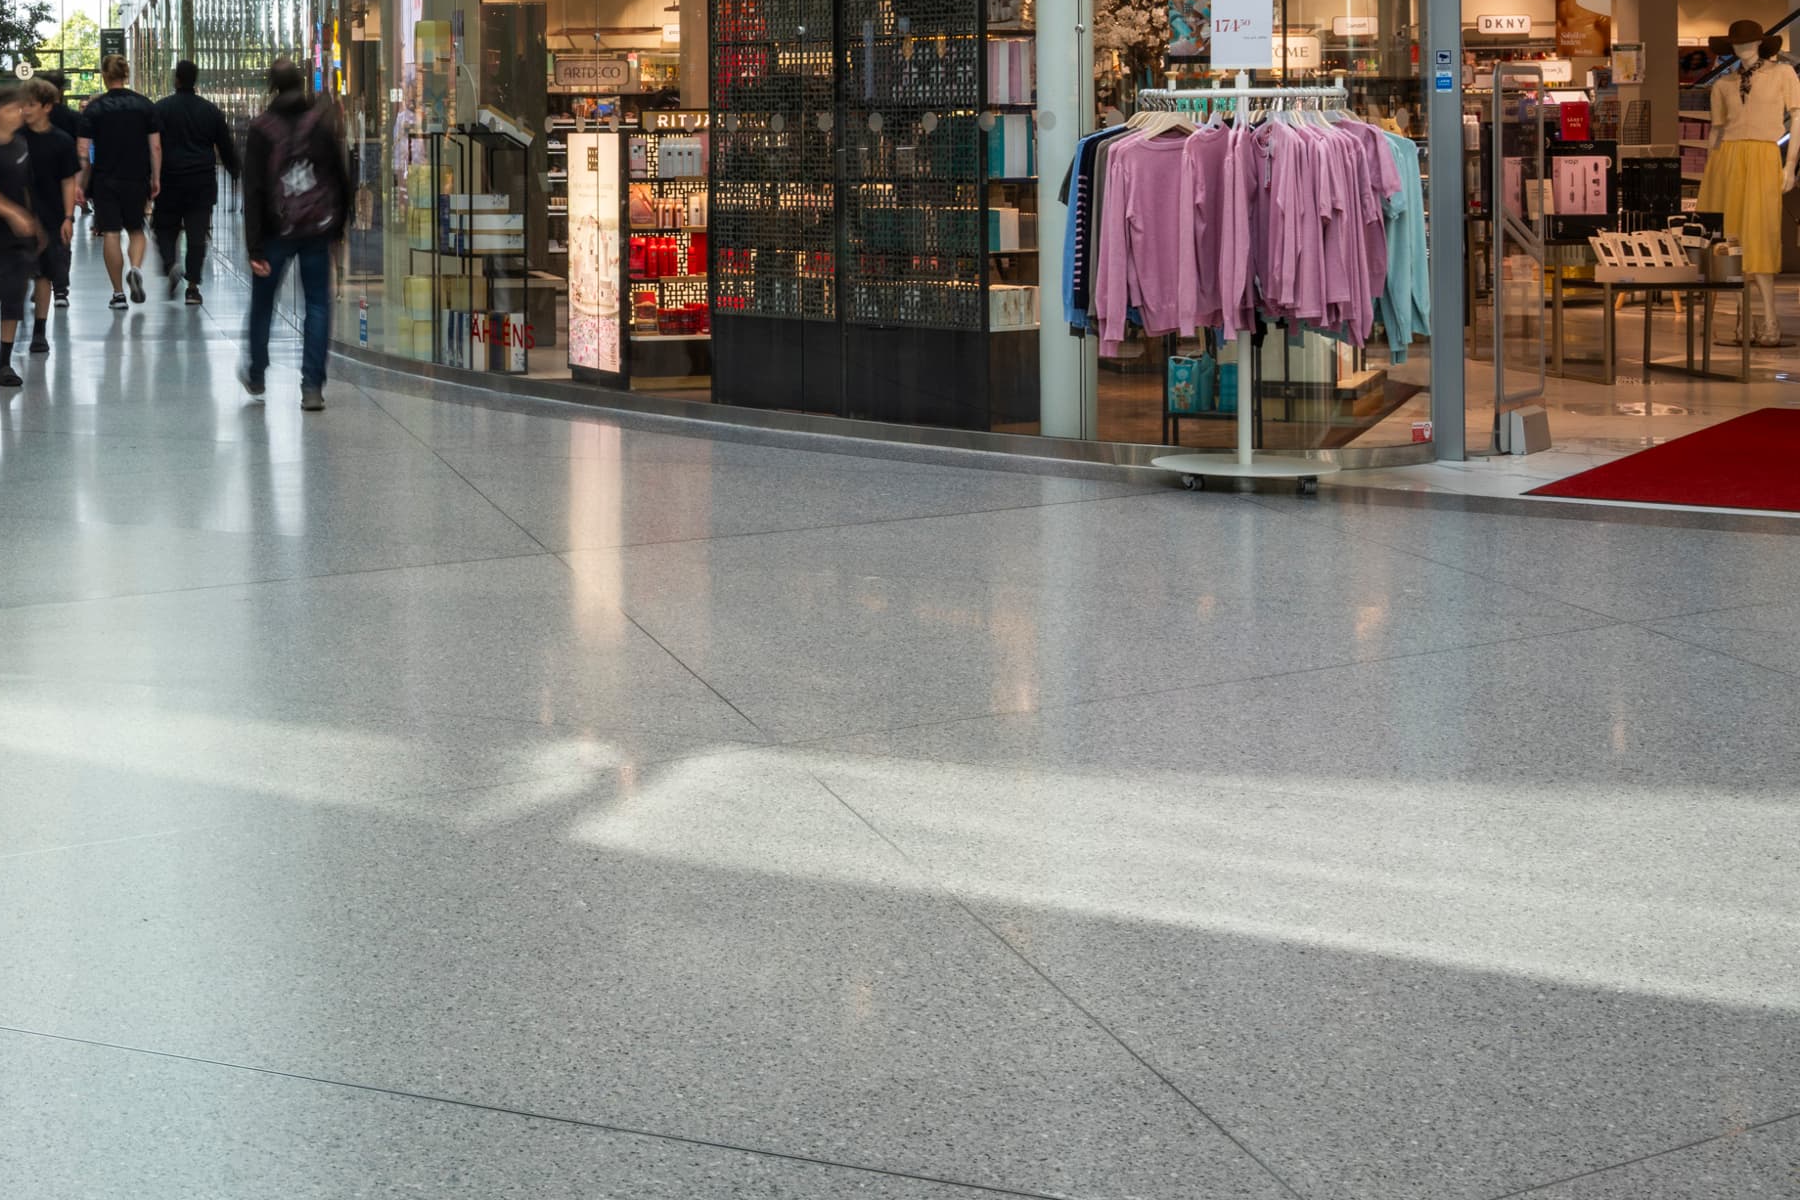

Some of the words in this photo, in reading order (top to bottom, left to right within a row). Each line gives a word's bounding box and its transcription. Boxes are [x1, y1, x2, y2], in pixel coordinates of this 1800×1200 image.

[1485, 18, 1525, 29] DKNY
[21, 65, 29, 76] B
[471, 309, 536, 350] ÅHLÉNS
